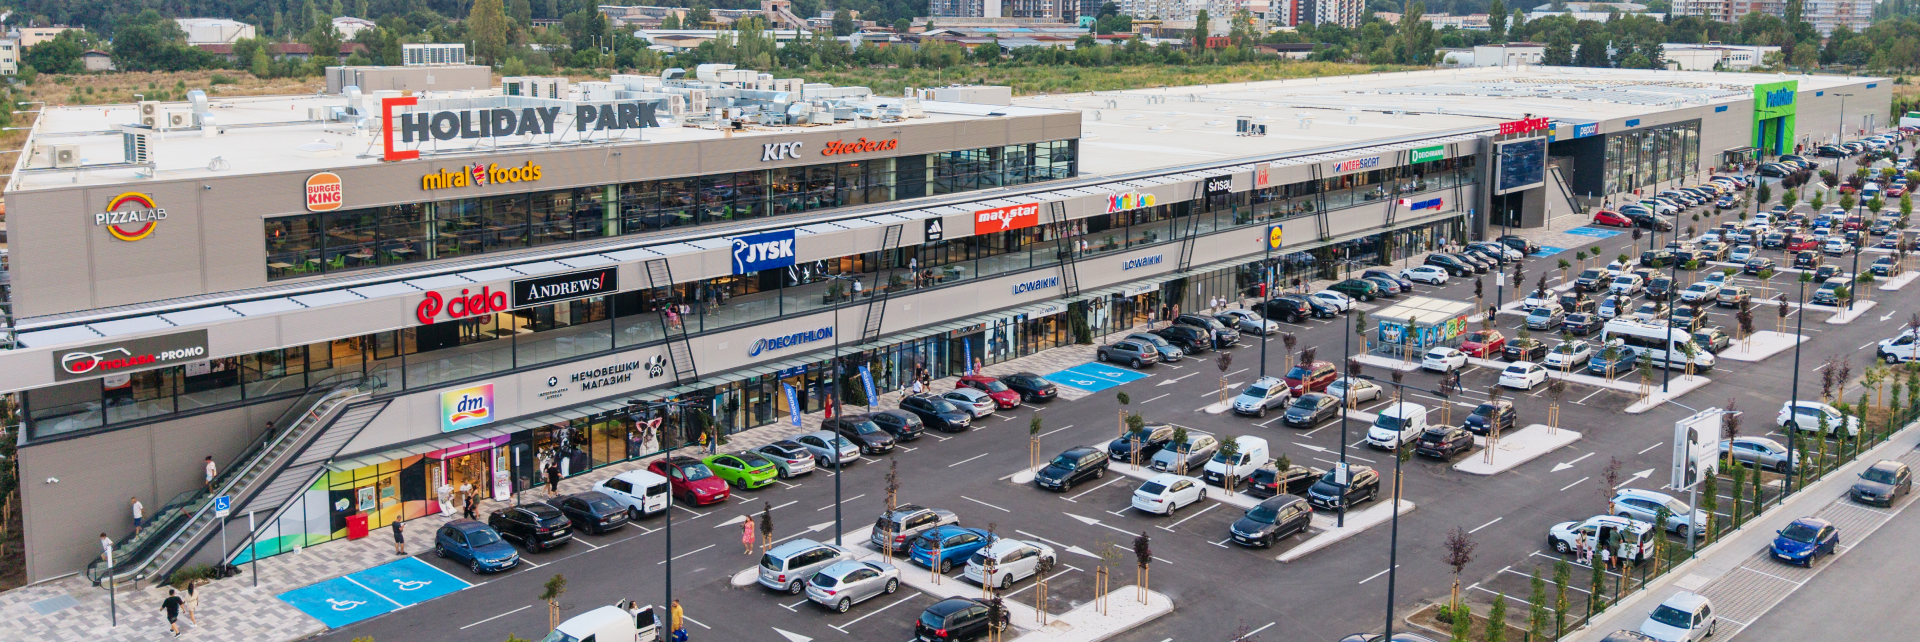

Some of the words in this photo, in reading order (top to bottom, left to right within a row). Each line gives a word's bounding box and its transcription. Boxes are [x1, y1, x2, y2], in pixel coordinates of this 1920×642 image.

[402, 106, 561, 143] HOLIDAY
[577, 101, 660, 132] PARK
[761, 141, 802, 162] KFC
[822, 137, 898, 156] Неделя
[1341, 157, 1380, 171] INTERSPORT
[423, 165, 470, 190] miral
[489, 161, 542, 183] foods
[308, 184, 340, 194] BURGER
[308, 191, 341, 204] KING
[978, 209, 1004, 223] mat
[1009, 205, 1037, 218] star
[745, 238, 794, 263] JYSK
[447, 285, 508, 319] ciela
[767, 326, 833, 351] DECATHLON
[571, 360, 640, 383] НЕЧОВЕШКИ
[581, 373, 631, 391] МАГАЗИН
[457, 394, 484, 413] dm
